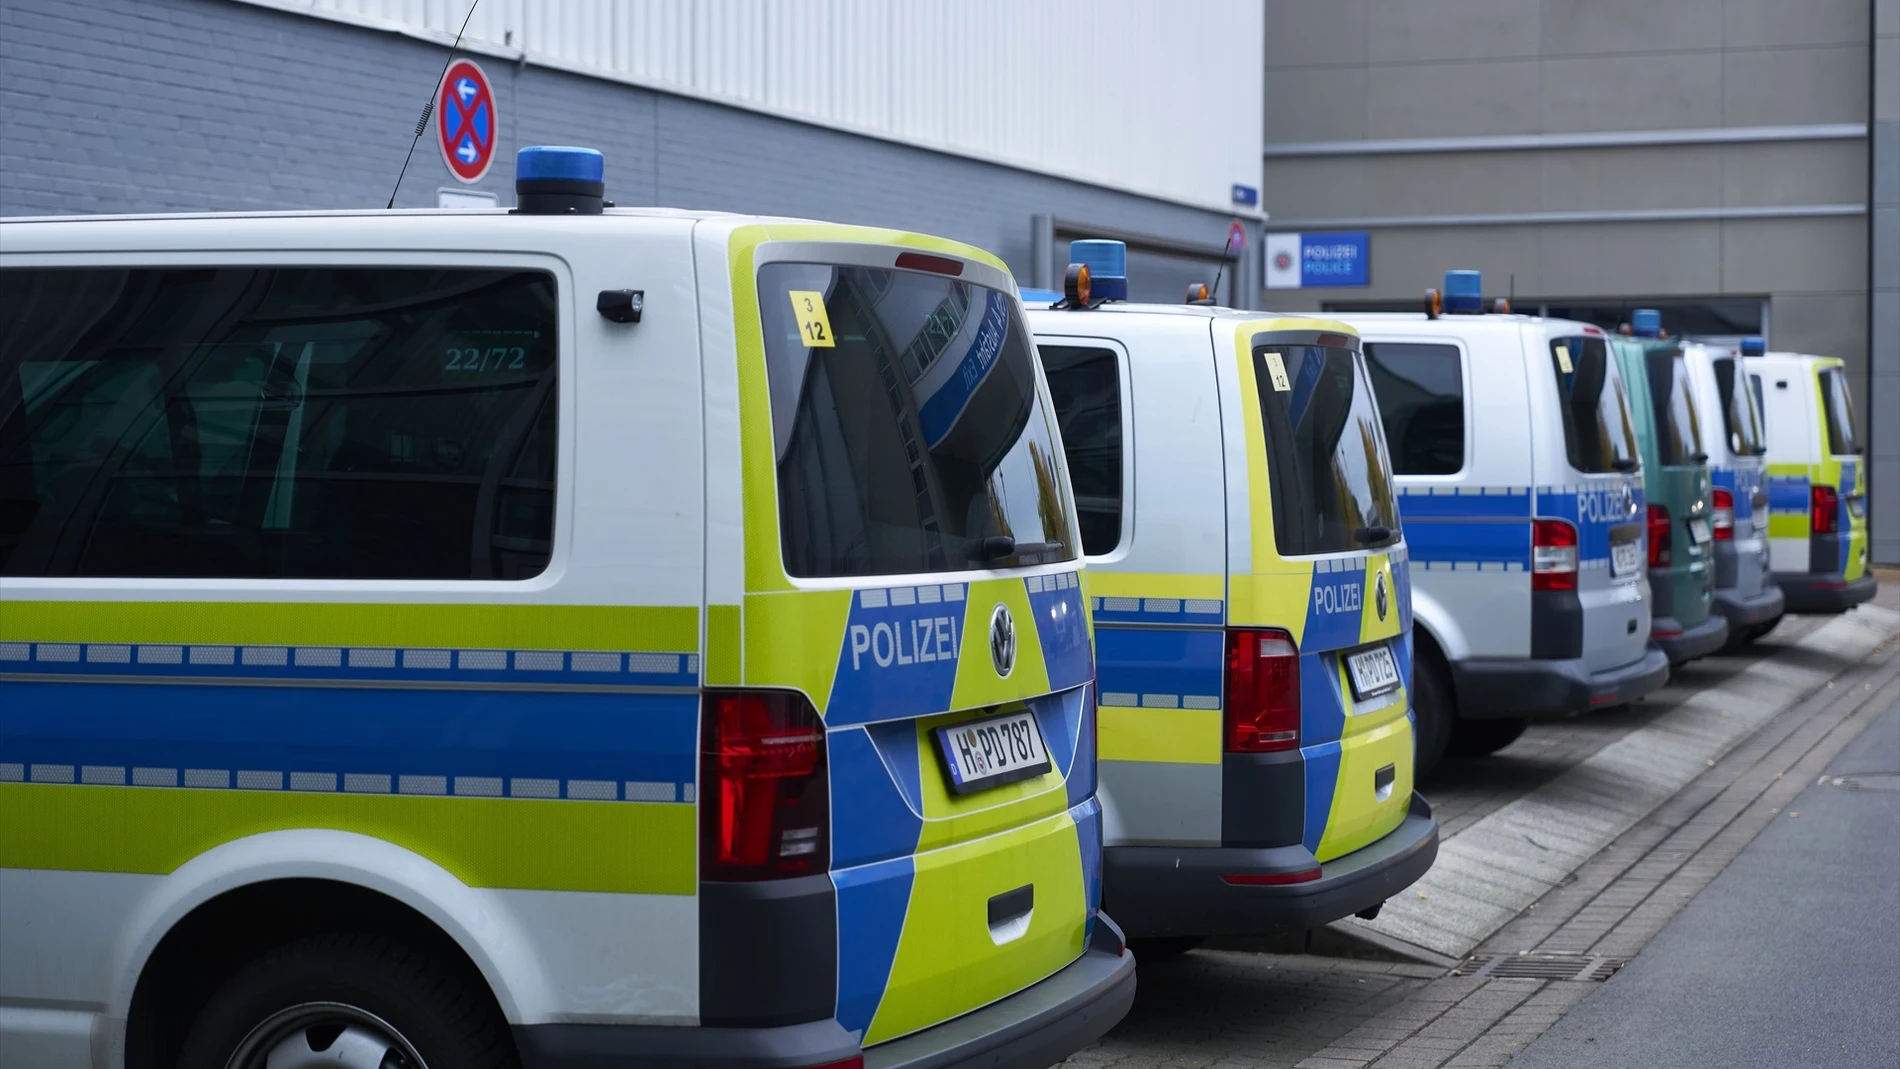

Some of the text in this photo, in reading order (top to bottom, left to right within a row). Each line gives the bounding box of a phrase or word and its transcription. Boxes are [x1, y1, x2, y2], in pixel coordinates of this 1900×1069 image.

[1304, 245, 1357, 259] POLIZEI
[1304, 261, 1352, 275] POLICE
[804, 298, 813, 312] 3
[805, 321, 826, 340] 12
[445, 347, 525, 372] 22/72
[1276, 375, 1286, 387] 12
[1314, 583, 1361, 615] POLIZEI
[851, 616, 958, 670] POLIZEI
